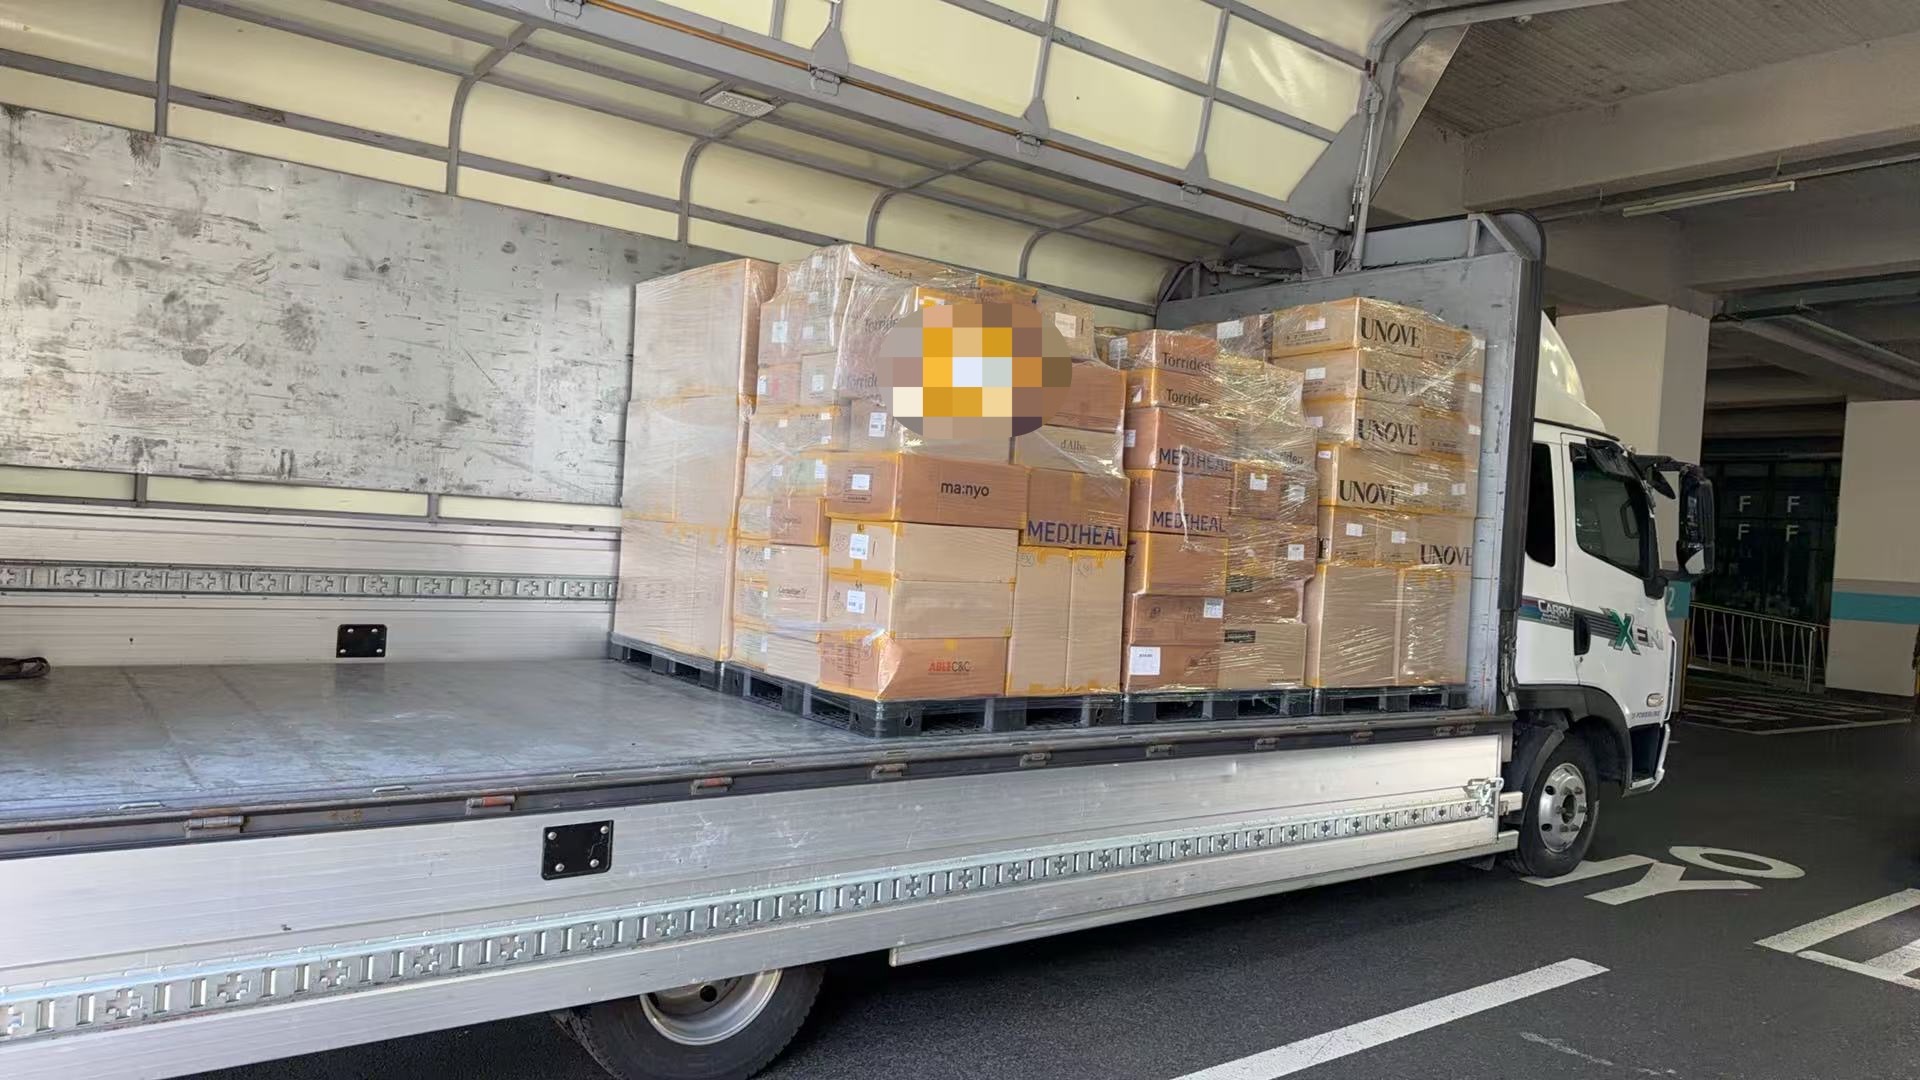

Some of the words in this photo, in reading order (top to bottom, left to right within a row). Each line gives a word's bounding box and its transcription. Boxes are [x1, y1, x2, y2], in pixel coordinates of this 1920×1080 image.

[1360, 316, 1422, 349] UNOVE
[1356, 417, 1419, 446] UNOVE
[1158, 447, 1233, 473] MEDIHEAL
[940, 482, 990, 500] ma:nyo
[1738, 495, 1752, 513] F
[1786, 495, 1801, 514] F
[1152, 510, 1227, 533] MEDIHEAL
[1736, 523, 1751, 541] F
[1027, 519, 1123, 547] MEDIHEAL
[1785, 524, 1800, 542] F
[1420, 543, 1473, 567] UNOVE
[1537, 599, 1571, 619] CARRY
